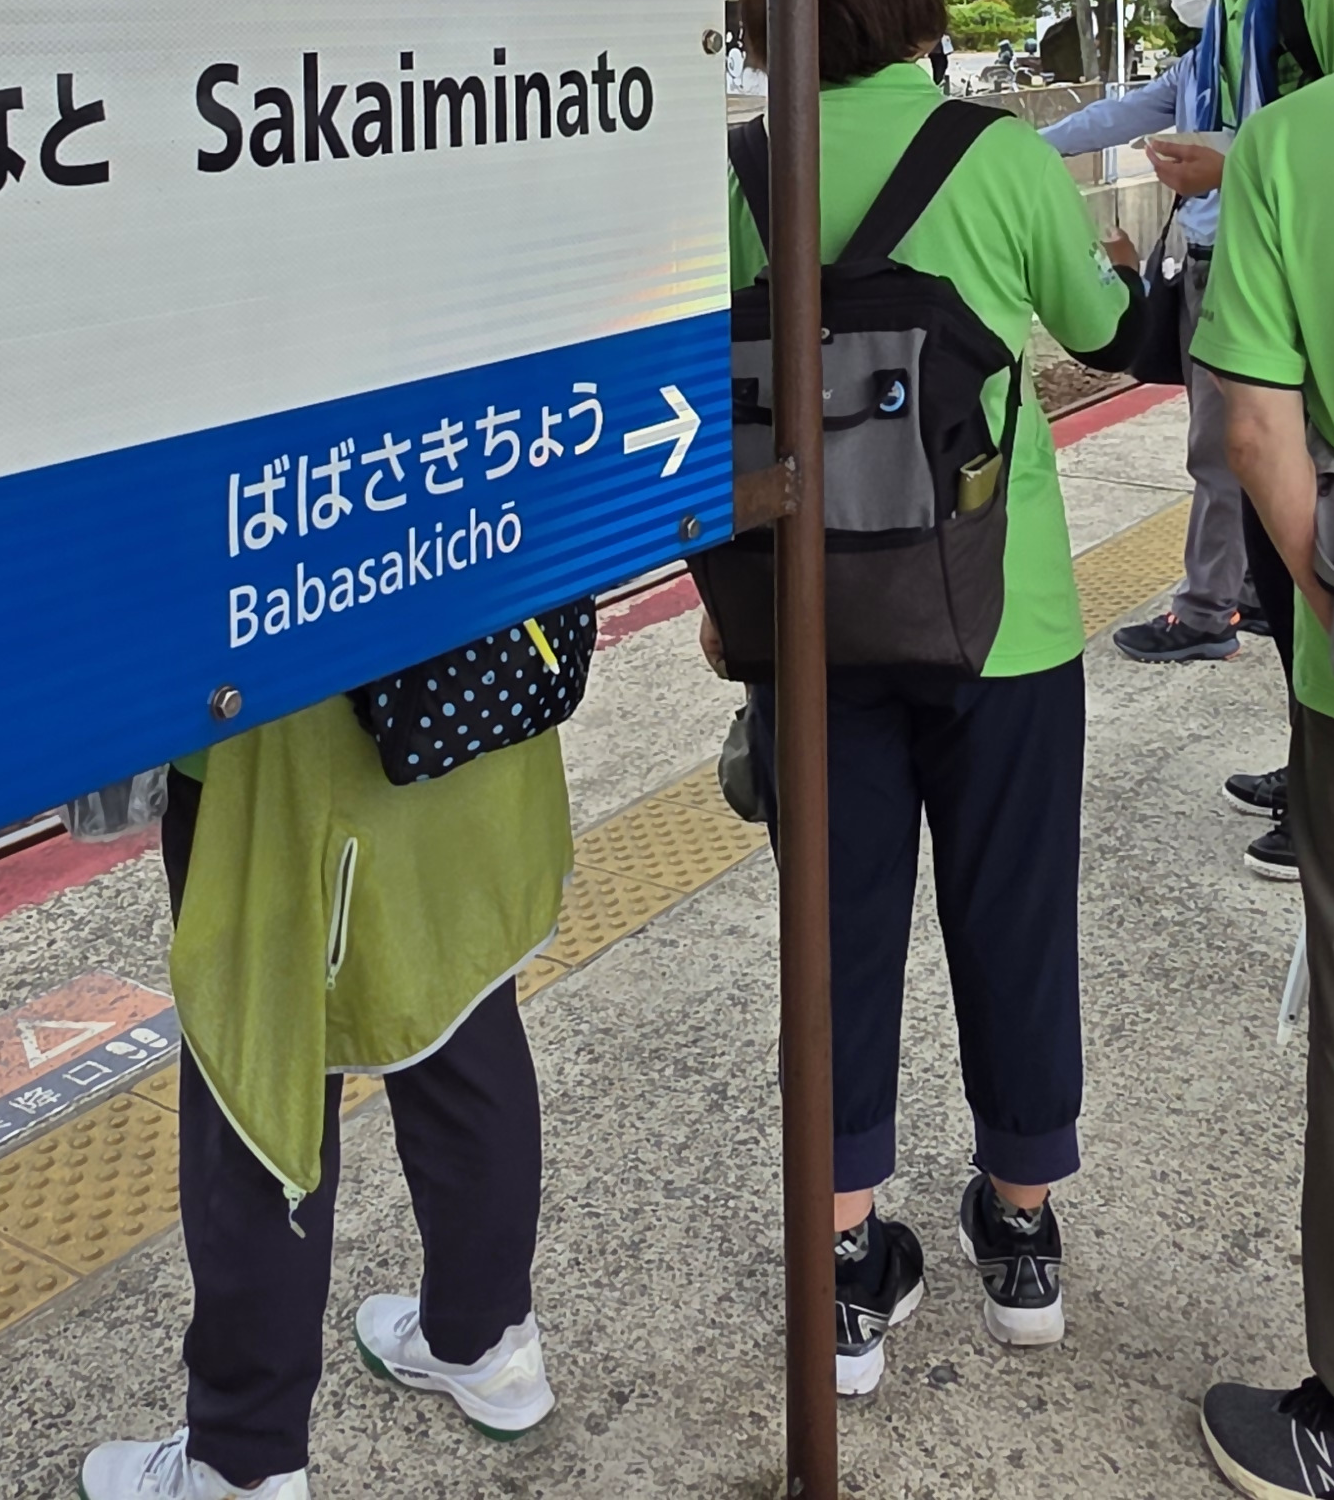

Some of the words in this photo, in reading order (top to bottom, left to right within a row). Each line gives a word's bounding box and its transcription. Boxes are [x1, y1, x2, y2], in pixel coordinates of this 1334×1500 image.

[195, 49, 655, 174] Sakaiminato
[228, 382, 604, 558] ばばさきちょう
[228, 501, 523, 649] Babasakichō
